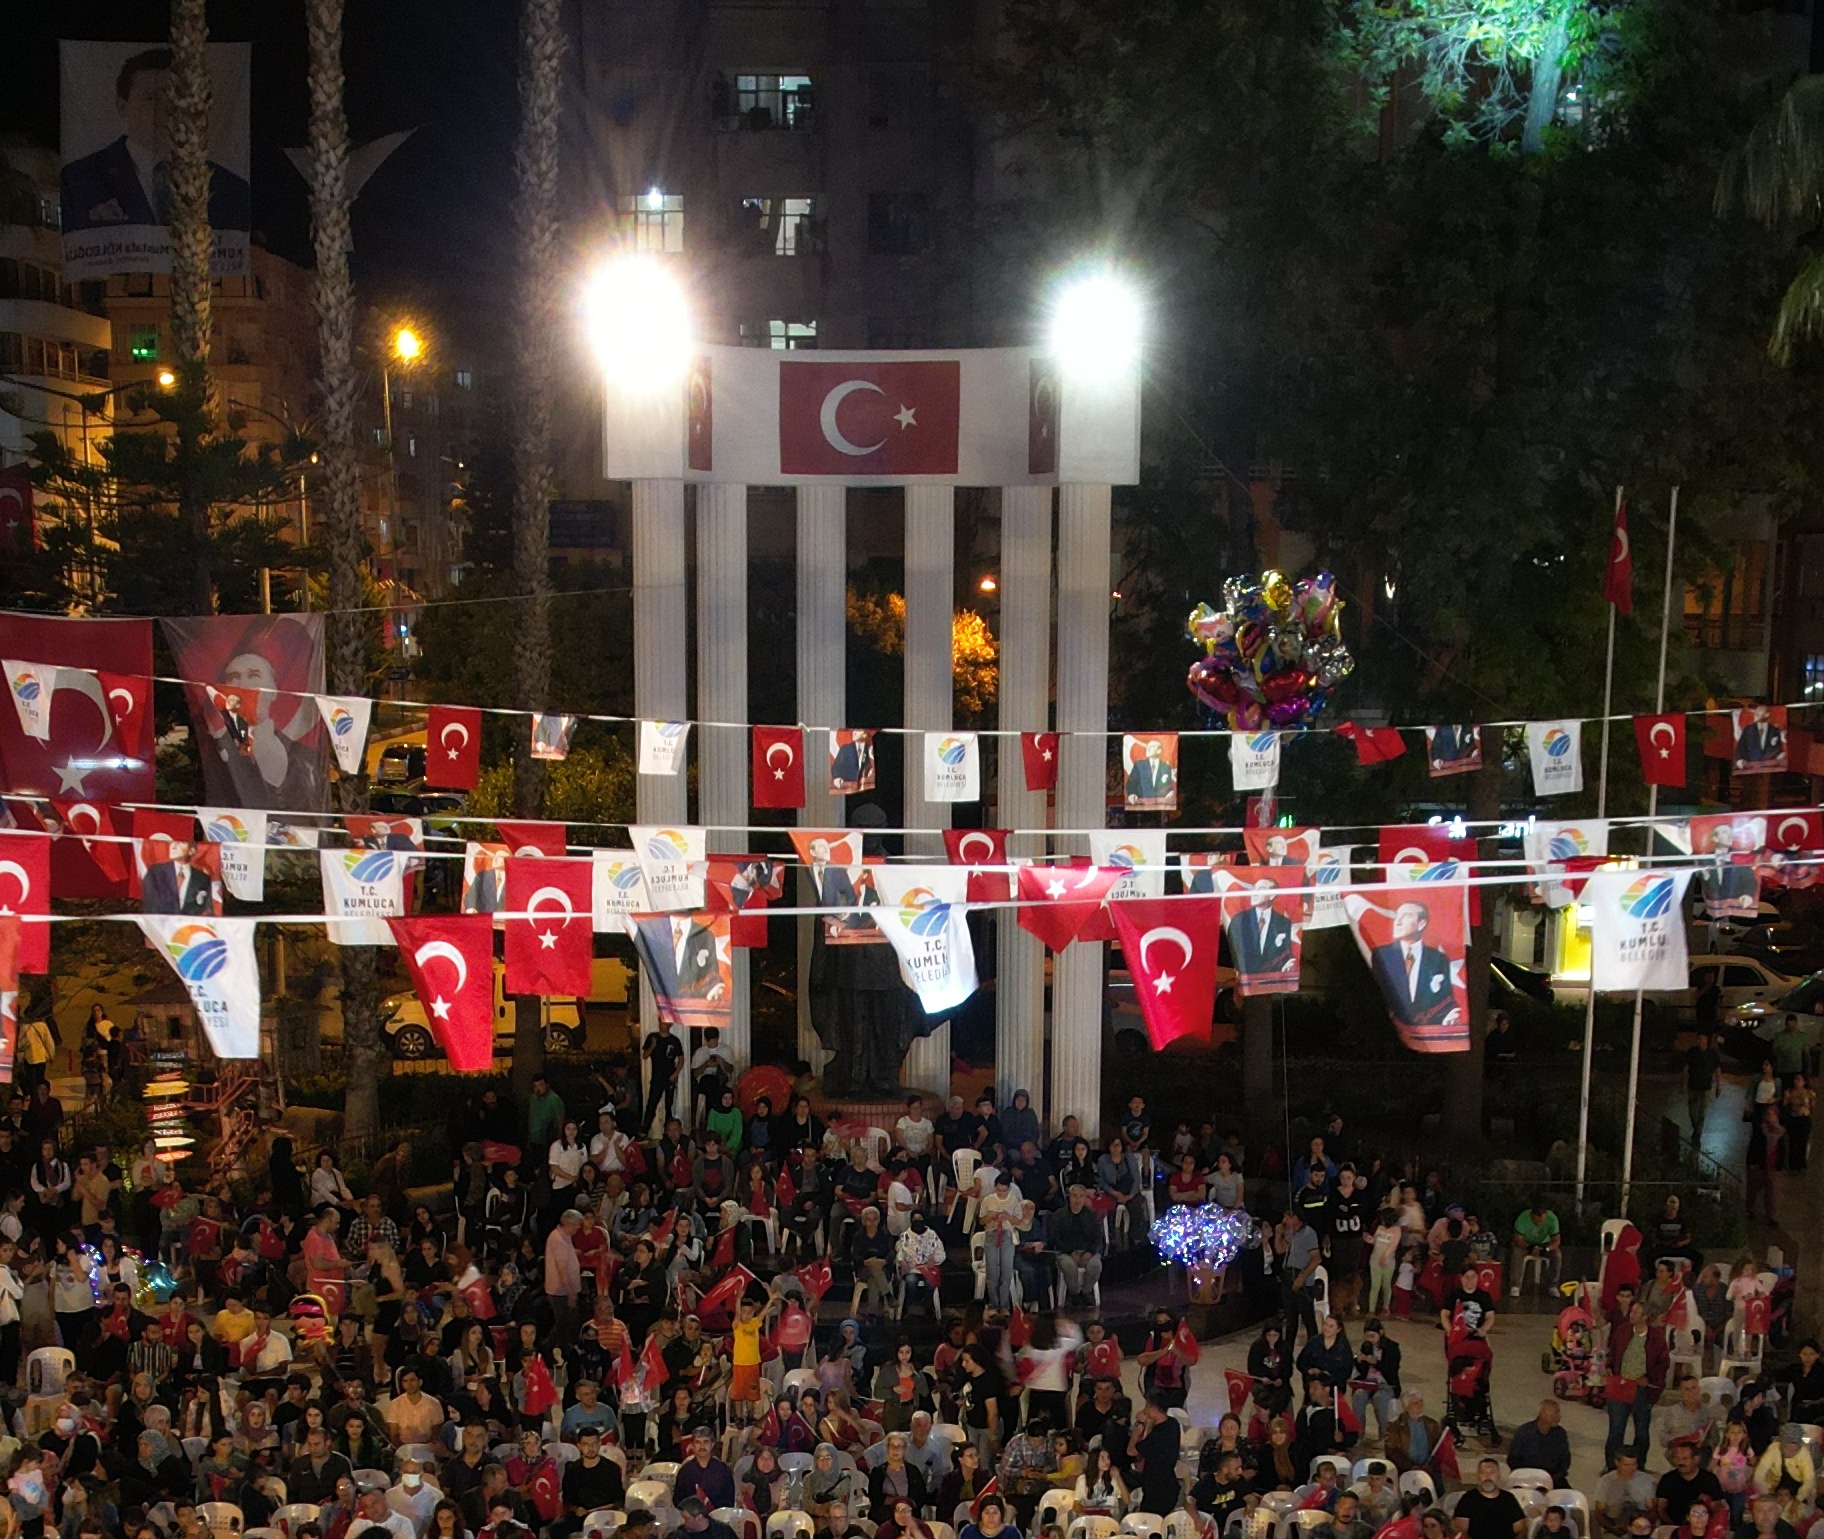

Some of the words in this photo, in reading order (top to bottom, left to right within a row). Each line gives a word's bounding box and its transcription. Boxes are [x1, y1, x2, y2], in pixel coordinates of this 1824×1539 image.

[360, 886, 378, 896] T.C.
[344, 897, 395, 909] KUMLUCA
[924, 940, 946, 953] T.C.
[1619, 934, 1667, 949] KUMLU
[907, 952, 948, 969] KUML
